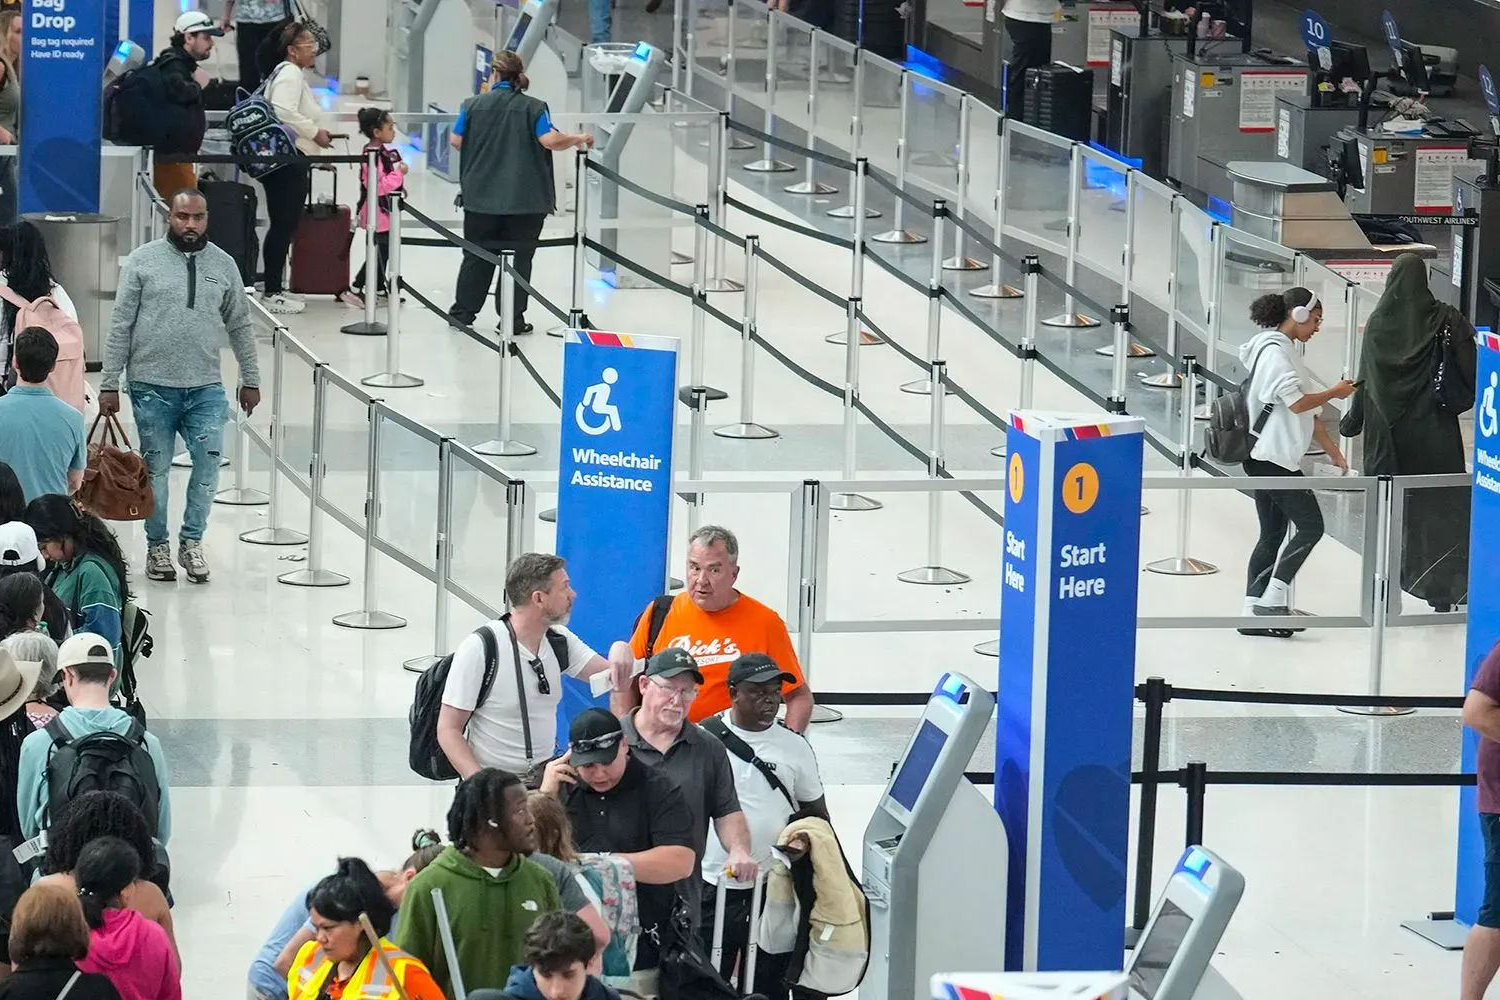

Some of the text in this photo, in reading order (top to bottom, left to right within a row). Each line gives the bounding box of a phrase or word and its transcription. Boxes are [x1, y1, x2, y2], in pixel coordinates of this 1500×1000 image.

[32, 0, 65, 12] Bag
[31, 12, 76, 33] Drop
[1306, 18, 1324, 40] 10
[1385, 22, 1397, 40] 11
[31, 37, 94, 48] Bag tag required
[30, 50, 85, 60] Have ID ready
[572, 447, 662, 471] Wheelchair
[570, 470, 654, 492] Assistance
[1075, 476, 1085, 501] 1
[1475, 470, 1500, 495] Assista
[1006, 529, 1026, 562] Start
[1059, 542, 1107, 569] Start
[1005, 561, 1025, 593] Here
[1059, 576, 1106, 600] Here
